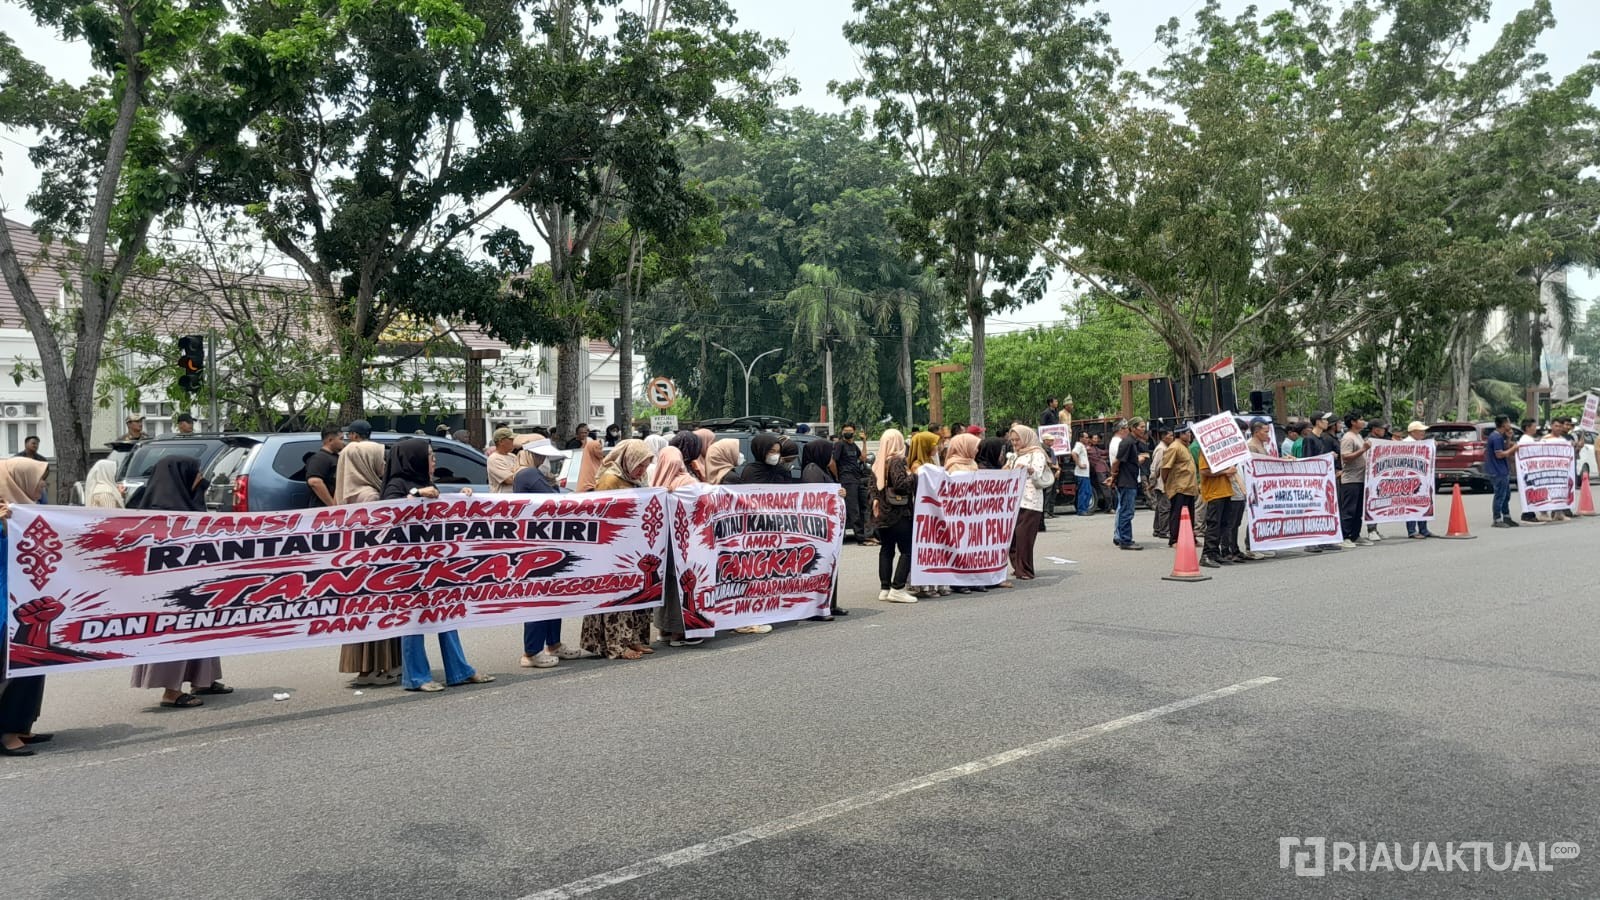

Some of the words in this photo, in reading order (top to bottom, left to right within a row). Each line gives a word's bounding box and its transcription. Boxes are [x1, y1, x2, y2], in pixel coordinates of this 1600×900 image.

[735, 491, 799, 511] MASYARAKAT
[801, 491, 829, 512] ADAT
[1274, 490, 1293, 502] HARUS
[1293, 489, 1313, 501] TEGAS
[140, 513, 299, 539] ALIANSI
[311, 499, 530, 531] MASYARAKAT
[532, 496, 614, 519] ADAT
[747, 514, 799, 533] KAMPAR
[801, 515, 828, 539] KIRI
[1256, 520, 1281, 537] TANGKAP
[148, 532, 341, 572] RANTAU
[354, 521, 518, 549] KAMPAR
[526, 520, 598, 541] KIRI
[742, 534, 782, 549] (AMAR)
[332, 543, 459, 568] (AMAR)
[718, 544, 815, 581] TANGKAP
[198, 549, 565, 609] TANGKAP
[80, 615, 147, 642] DAN
[154, 599, 339, 633] PENJARAKAN
[342, 584, 485, 615] HARAPAN
[485, 574, 644, 601] NAINGGOLAN
[735, 599, 750, 615] DAN
[307, 615, 369, 637] DAN
[377, 612, 410, 630] CS
[418, 604, 467, 624] NYA
